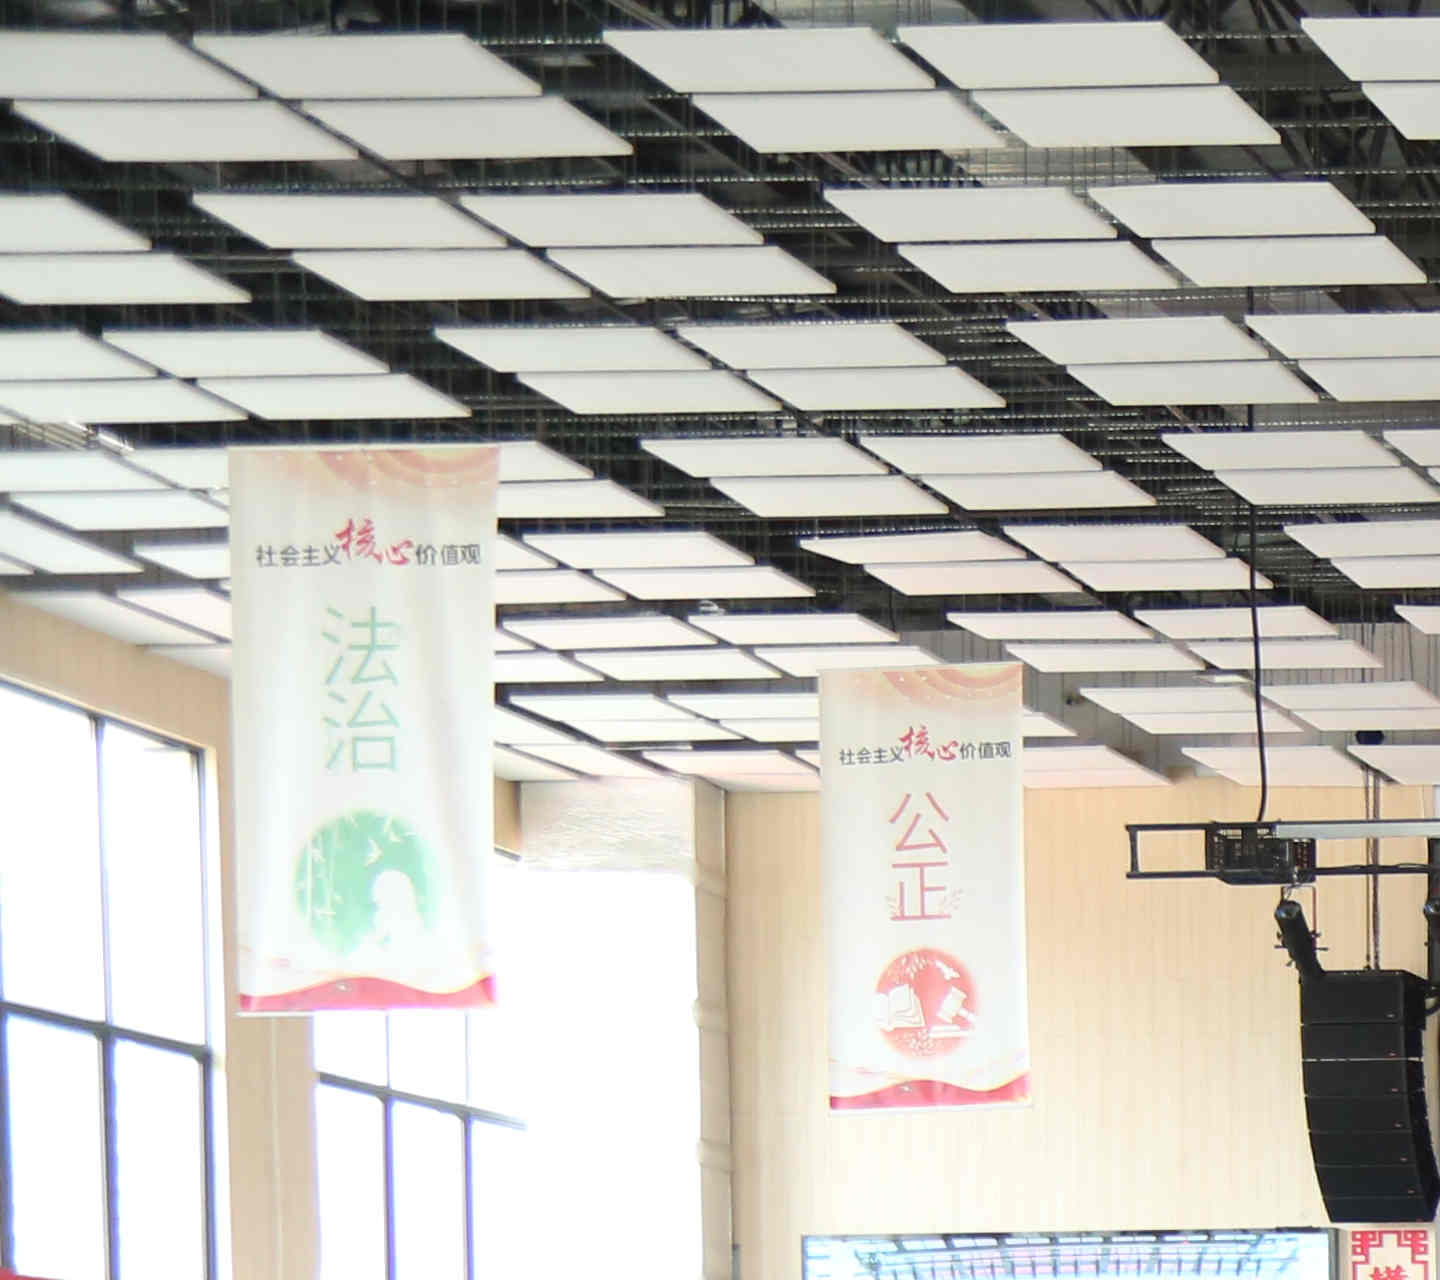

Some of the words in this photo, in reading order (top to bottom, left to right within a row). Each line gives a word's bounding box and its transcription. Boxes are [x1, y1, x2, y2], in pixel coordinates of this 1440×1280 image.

[255, 517, 481, 567] 社会主义核心价值观
[321, 606, 399, 772] 法治
[839, 725, 1011, 767] 社会主义核心价值观
[888, 791, 952, 921] 公正
